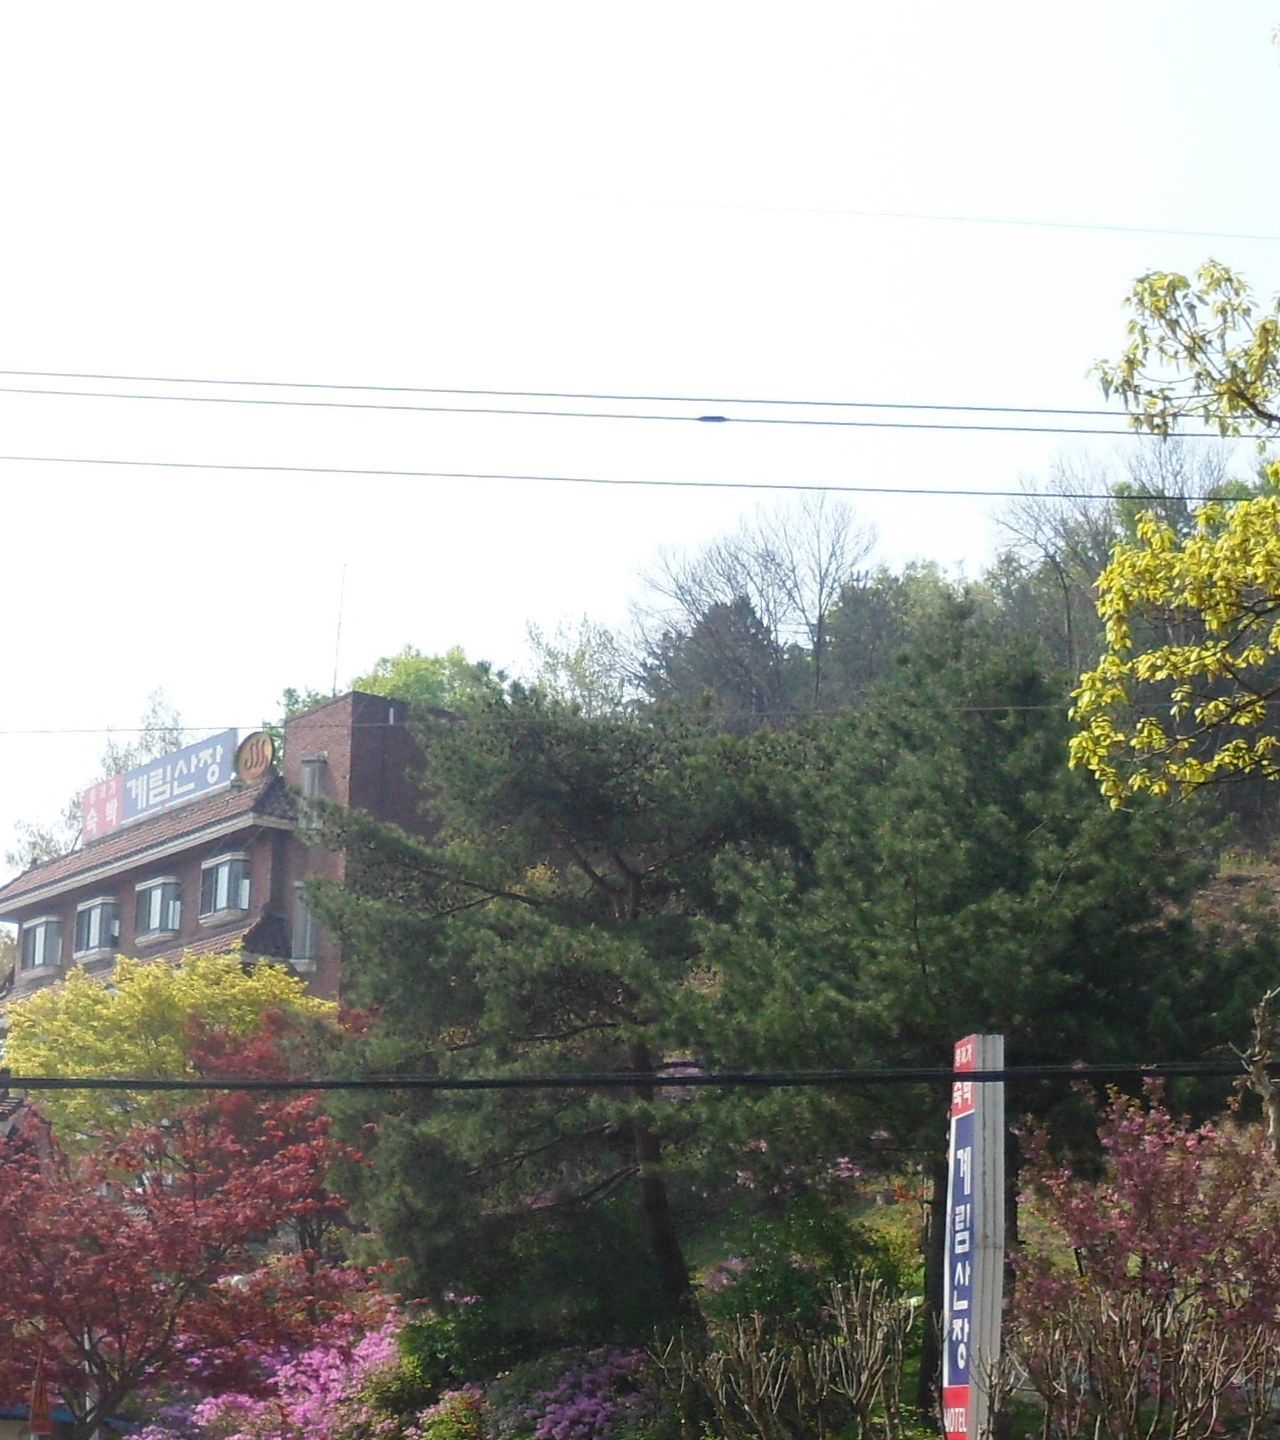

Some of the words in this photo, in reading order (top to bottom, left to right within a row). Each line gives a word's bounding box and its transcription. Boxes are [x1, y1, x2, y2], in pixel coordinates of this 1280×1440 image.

[126, 744, 224, 809] 계림산장
[951, 1146, 972, 1370] 계림산장
[943, 1407, 967, 1433] MOTEL
